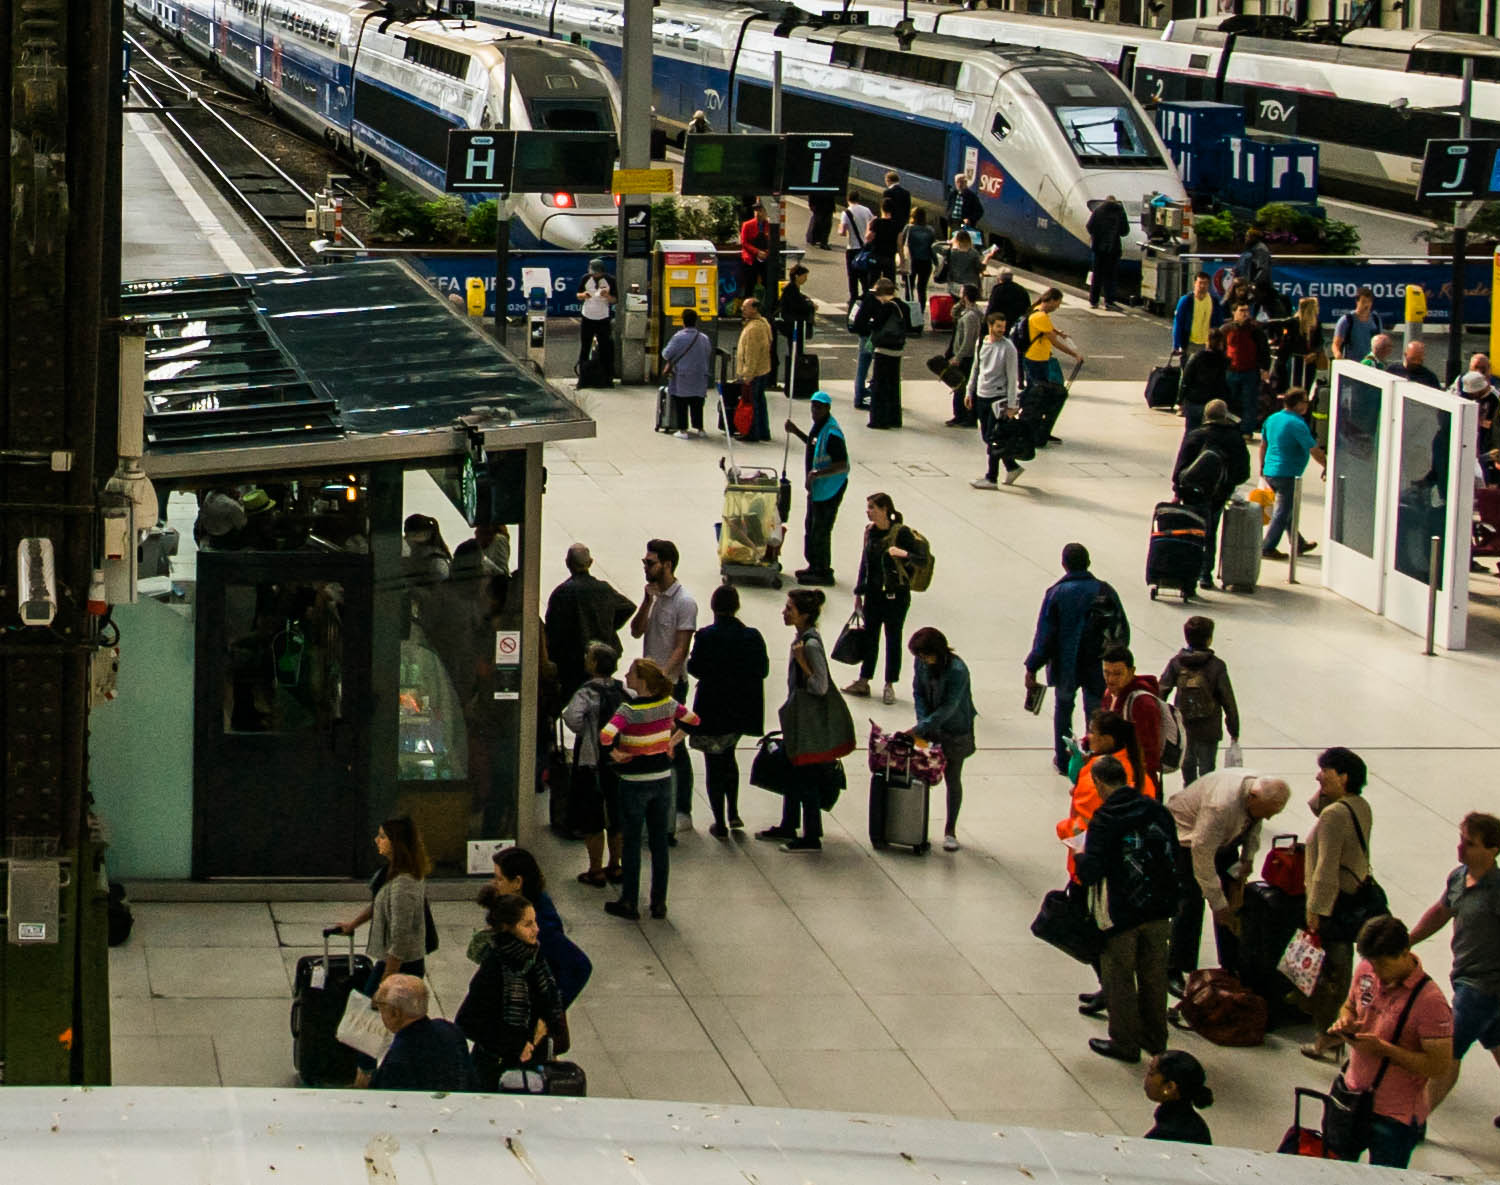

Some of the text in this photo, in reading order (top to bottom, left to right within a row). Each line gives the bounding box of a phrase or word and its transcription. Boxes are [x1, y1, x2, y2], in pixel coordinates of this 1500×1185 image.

[1260, 100, 1296, 122] TGV
[466, 149, 495, 179] H
[1442, 158, 1467, 188] J
[978, 174, 1003, 194] SNCF
[1309, 283, 1356, 297] EURO
